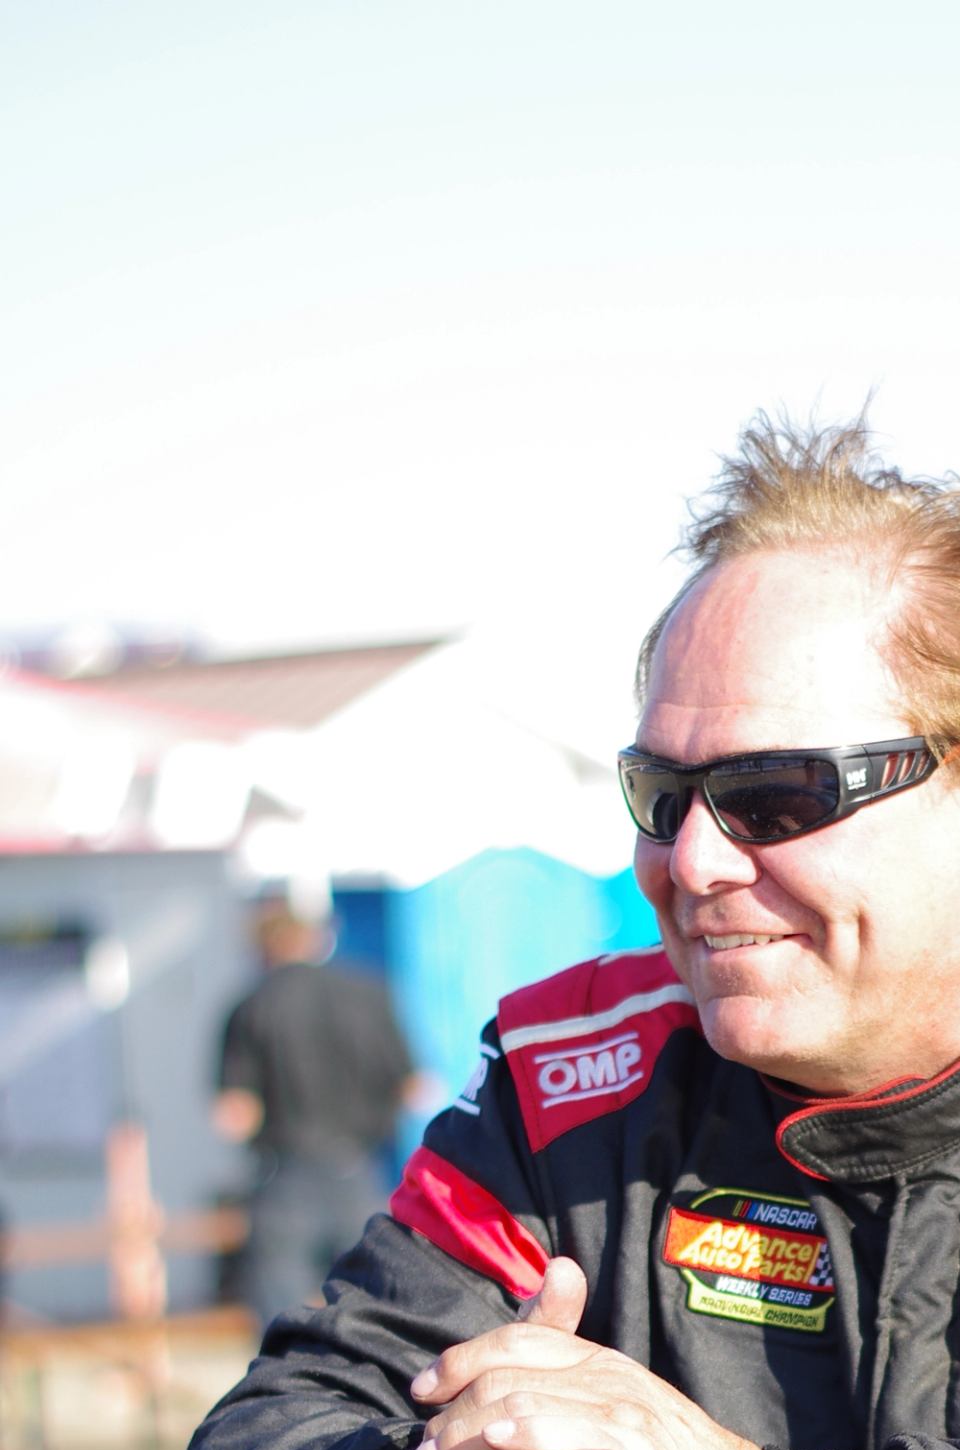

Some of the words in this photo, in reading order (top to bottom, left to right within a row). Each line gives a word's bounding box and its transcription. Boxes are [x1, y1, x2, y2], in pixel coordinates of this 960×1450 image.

[539, 1042, 641, 1095] OMP
[754, 1203, 817, 1229] NASCAR
[692, 1219, 814, 1261] Advance
[677, 1244, 743, 1269] Auto
[742, 1253, 806, 1281] Parts
[715, 1276, 768, 1298] WEEKLY
[768, 1288, 813, 1306] SERIES
[765, 1309, 818, 1329] CHAMPION
